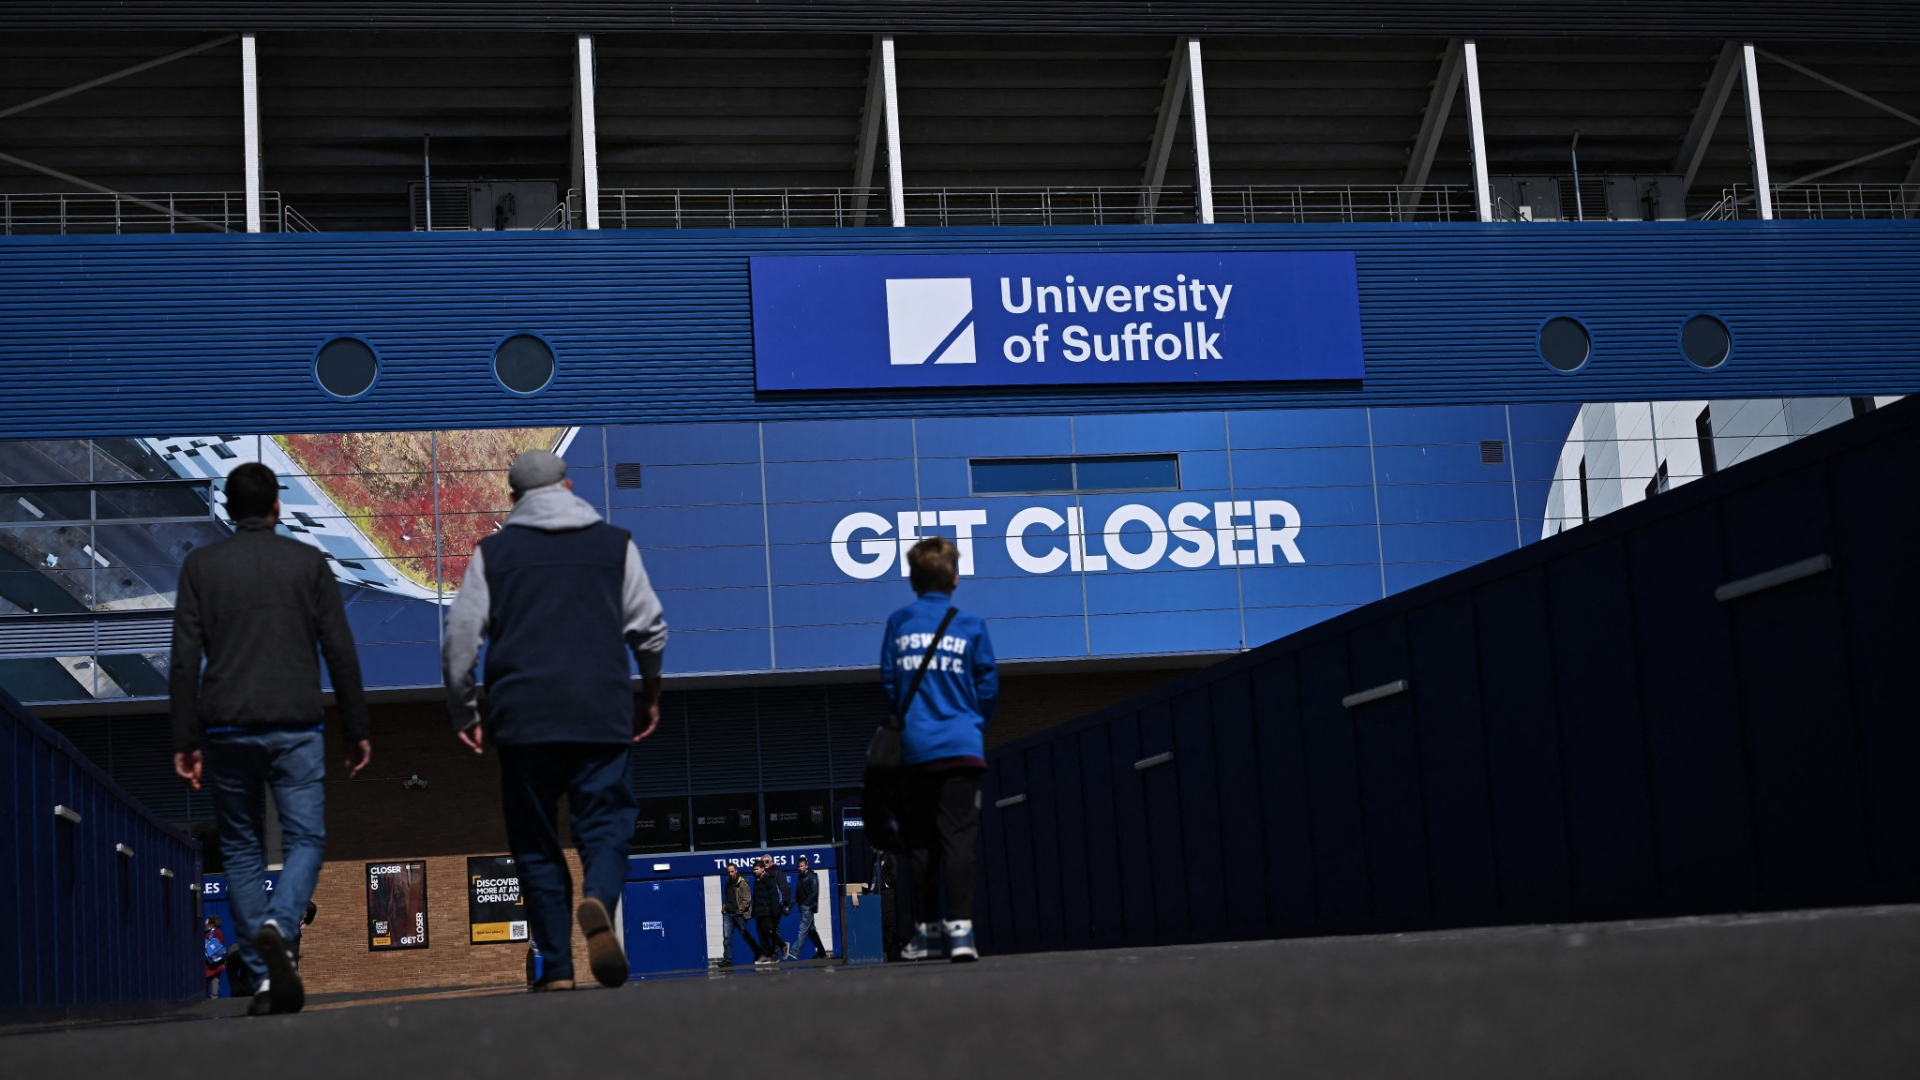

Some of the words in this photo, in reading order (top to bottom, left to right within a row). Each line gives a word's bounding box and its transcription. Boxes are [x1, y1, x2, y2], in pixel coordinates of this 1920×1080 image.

[1000, 274, 1232, 320] University
[1003, 322, 1049, 363] of
[1062, 321, 1224, 363] Suffolk
[830, 509, 987, 579] GET
[1006, 500, 1305, 574] CLOSER
[714, 855, 787, 869] TURNSES
[813, 853, 821, 864] 2
[370, 865, 402, 875] CLOSER
[203, 882, 220, 894] ES
[371, 874, 379, 890] GET
[476, 877, 519, 888] DISCOVER
[476, 887, 498, 895] MORE
[508, 885, 520, 893] AN
[477, 894, 502, 903] OPEN
[502, 893, 519, 902] DAY
[400, 936, 416, 944] GET
[416, 912, 425, 943] CLOSER
